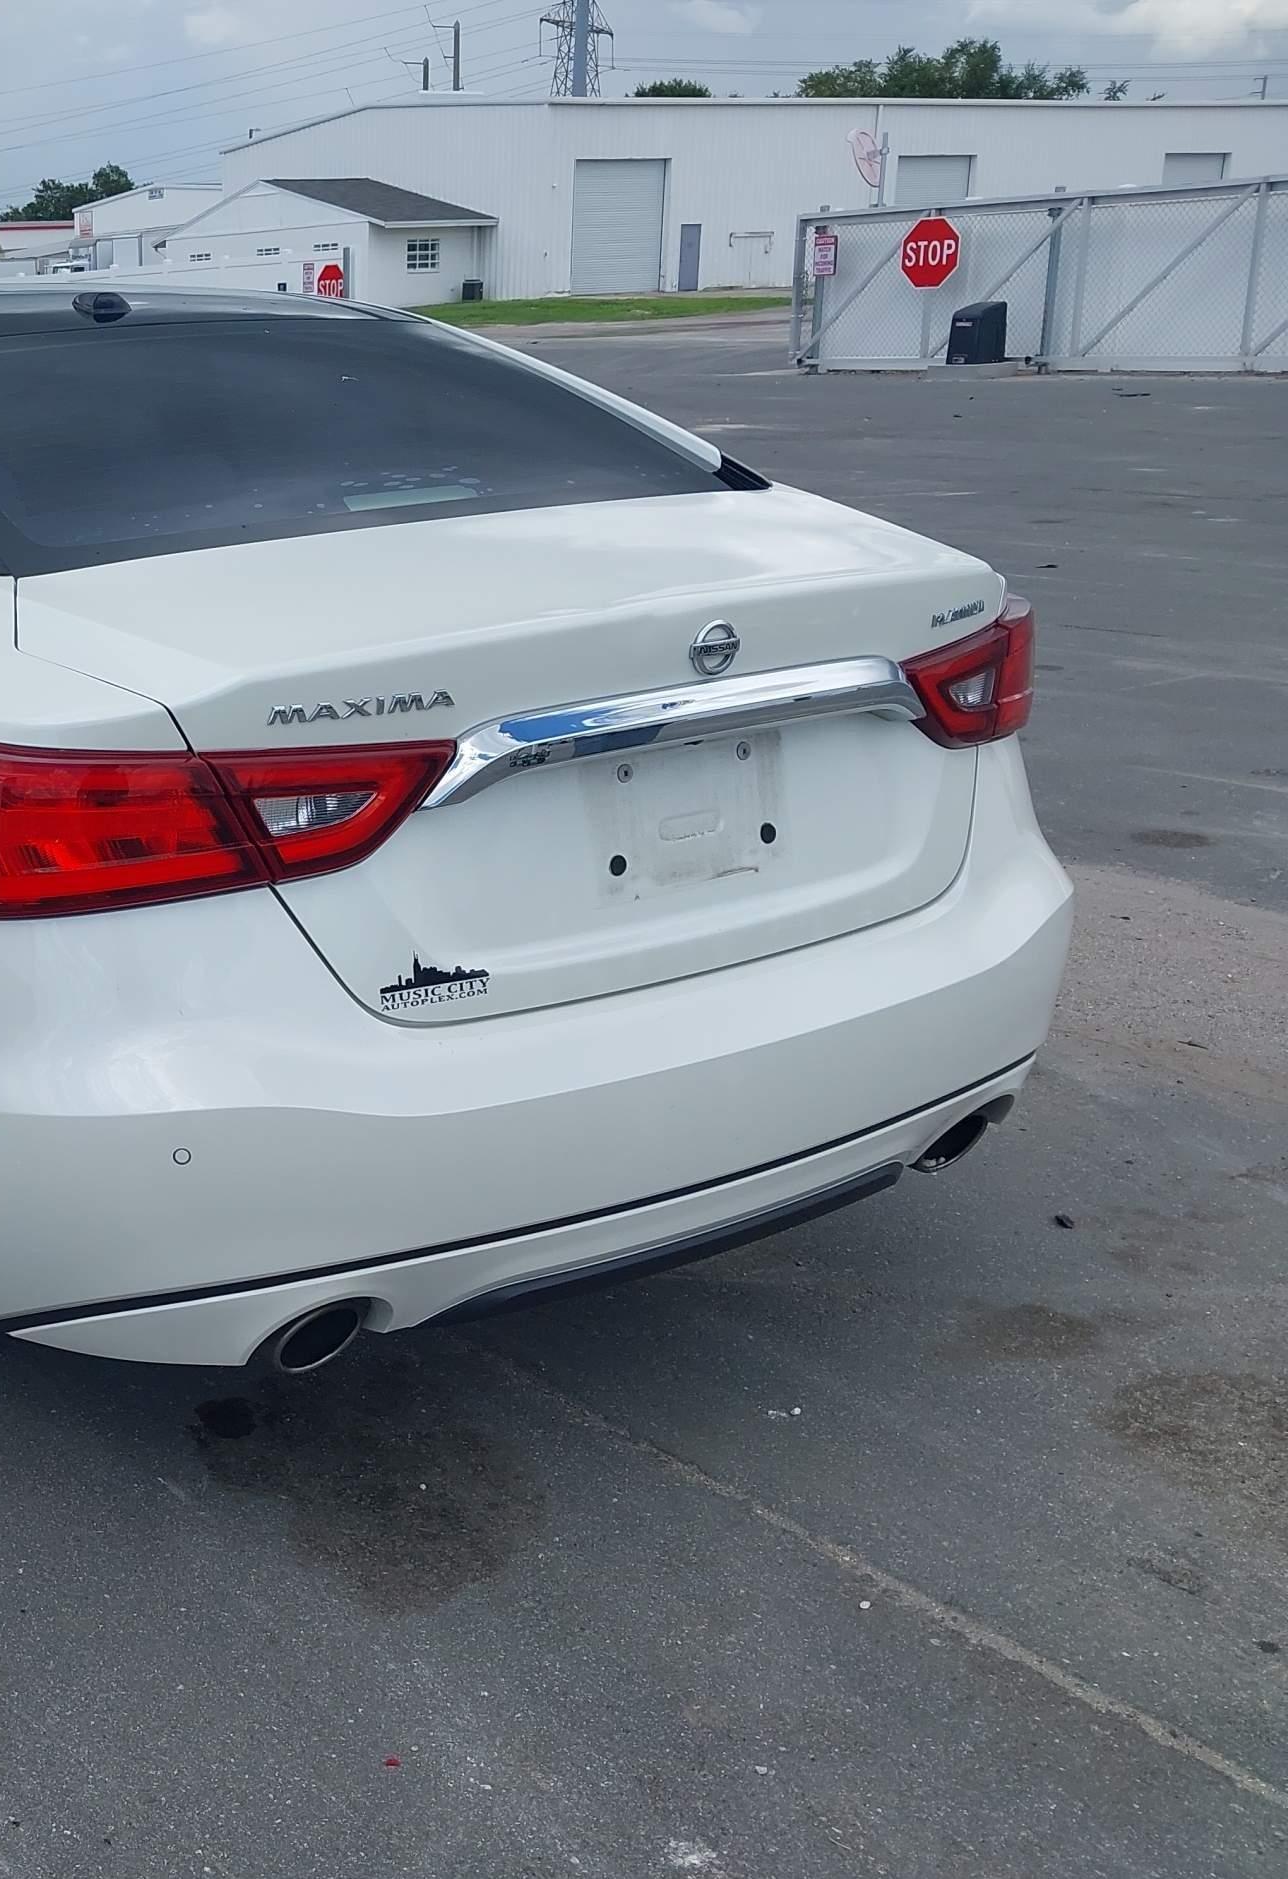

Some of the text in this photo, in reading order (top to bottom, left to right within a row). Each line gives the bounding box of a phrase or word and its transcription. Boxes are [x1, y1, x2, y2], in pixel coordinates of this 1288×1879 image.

[904, 239, 956, 267] STOP
[319, 279, 343, 297] STOP
[698, 641, 738, 655] NISSAN
[267, 688, 456, 726] MAXIMA
[380, 977, 490, 1006] MUSIC CITY
[381, 988, 489, 1012] AUTOPLEX.COM
